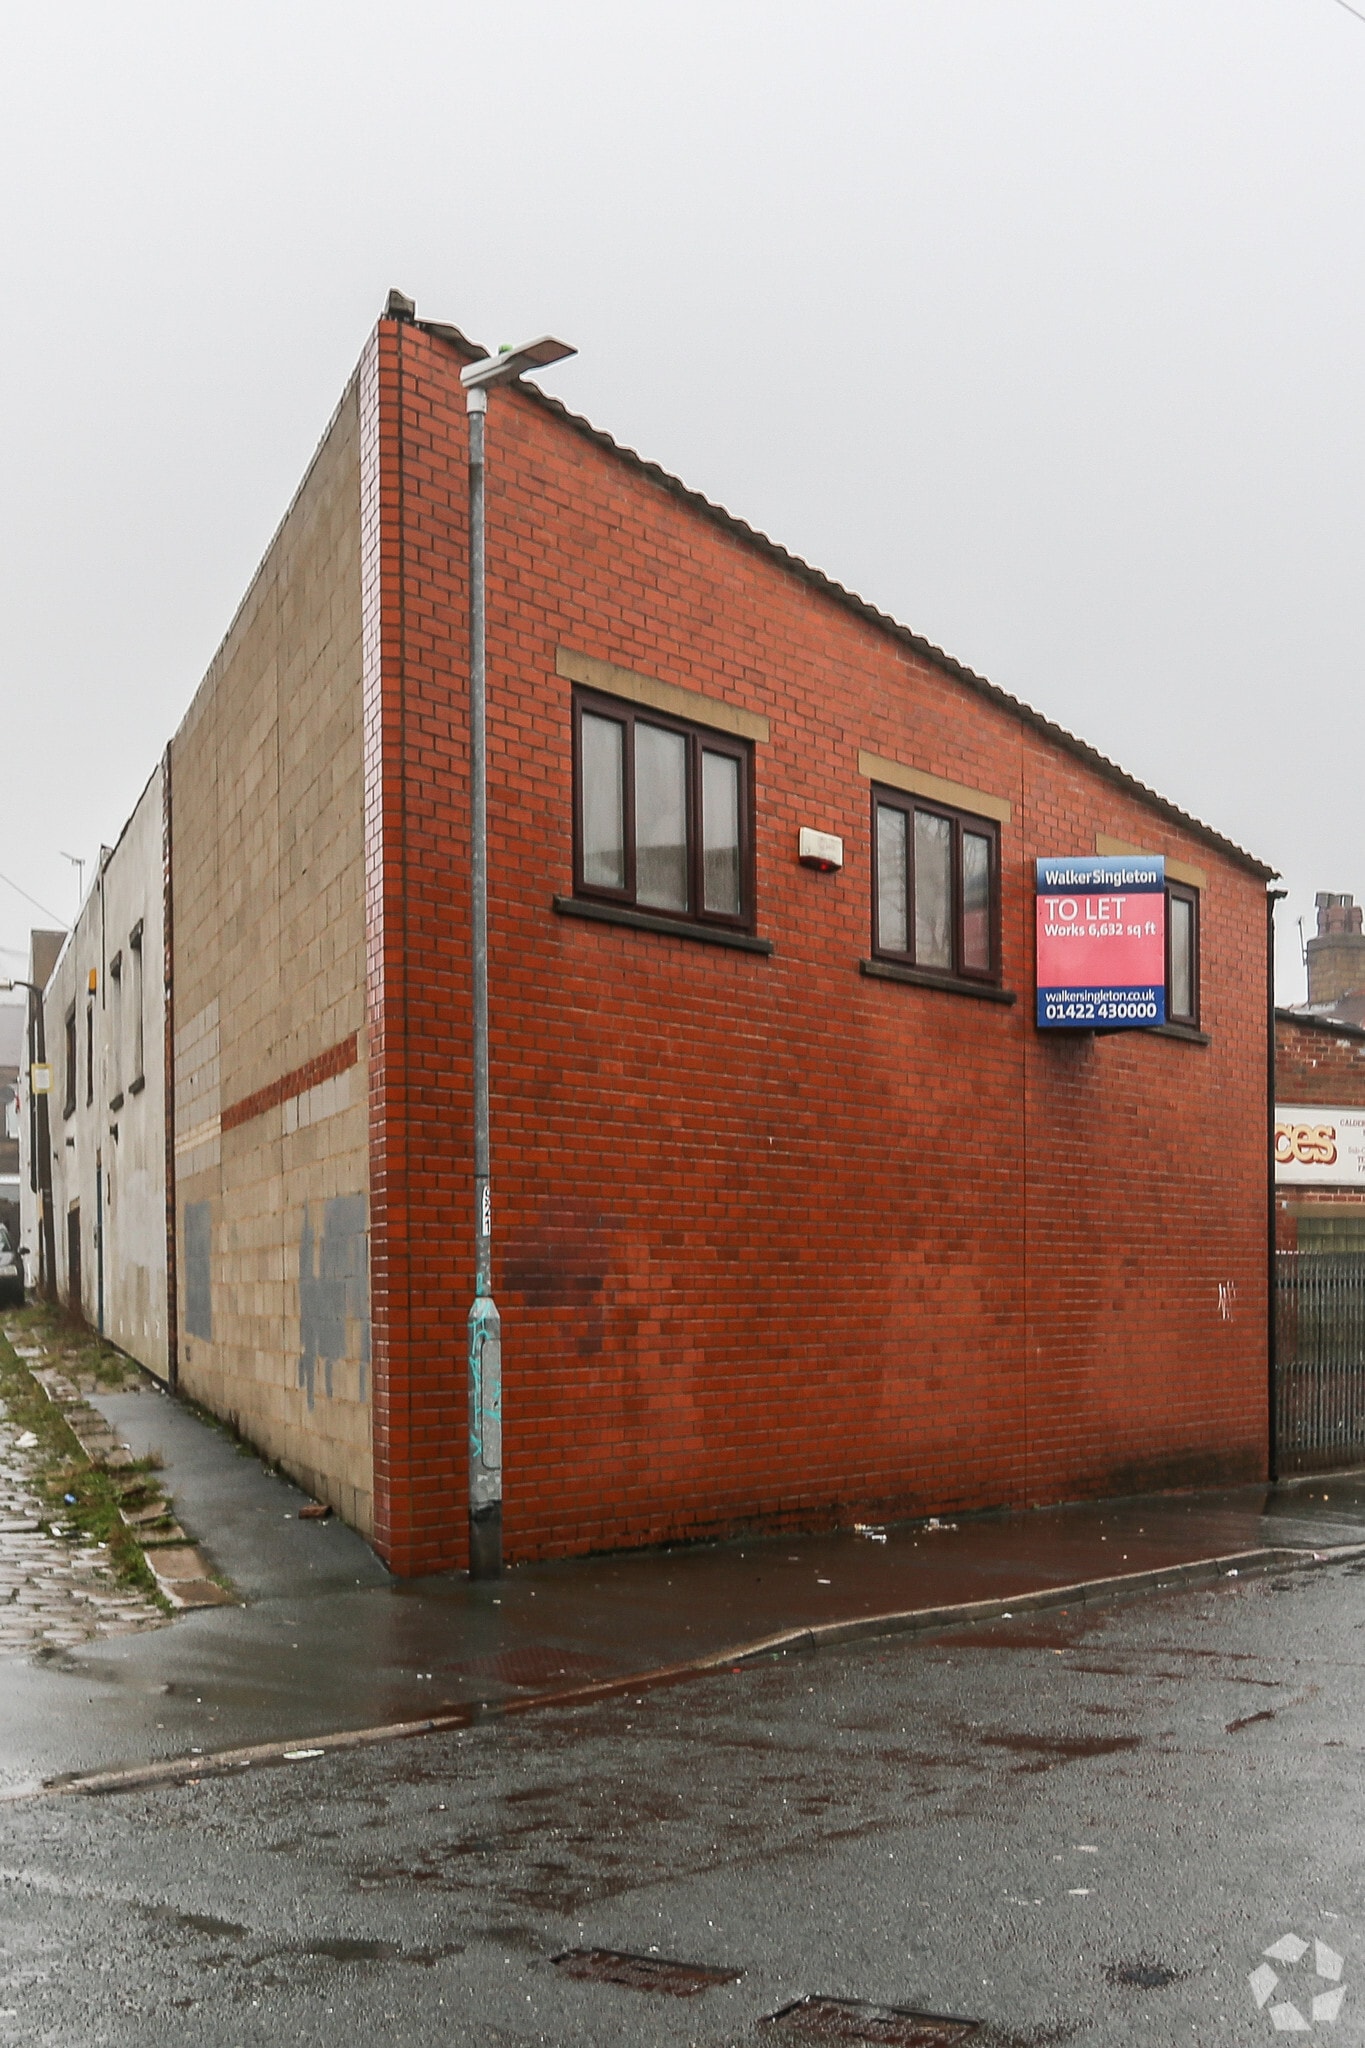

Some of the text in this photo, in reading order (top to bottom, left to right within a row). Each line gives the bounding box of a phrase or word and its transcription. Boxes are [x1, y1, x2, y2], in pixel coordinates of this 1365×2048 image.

[1044, 897, 1126, 921] TO LET
[1045, 923, 1085, 937] Works
[1127, 925, 1141, 939] sq
[1145, 922, 1156, 935] ft
[1045, 989, 1154, 1004] walkersingleton.co.uk
[1046, 1003, 1157, 1019] 01422 430000
